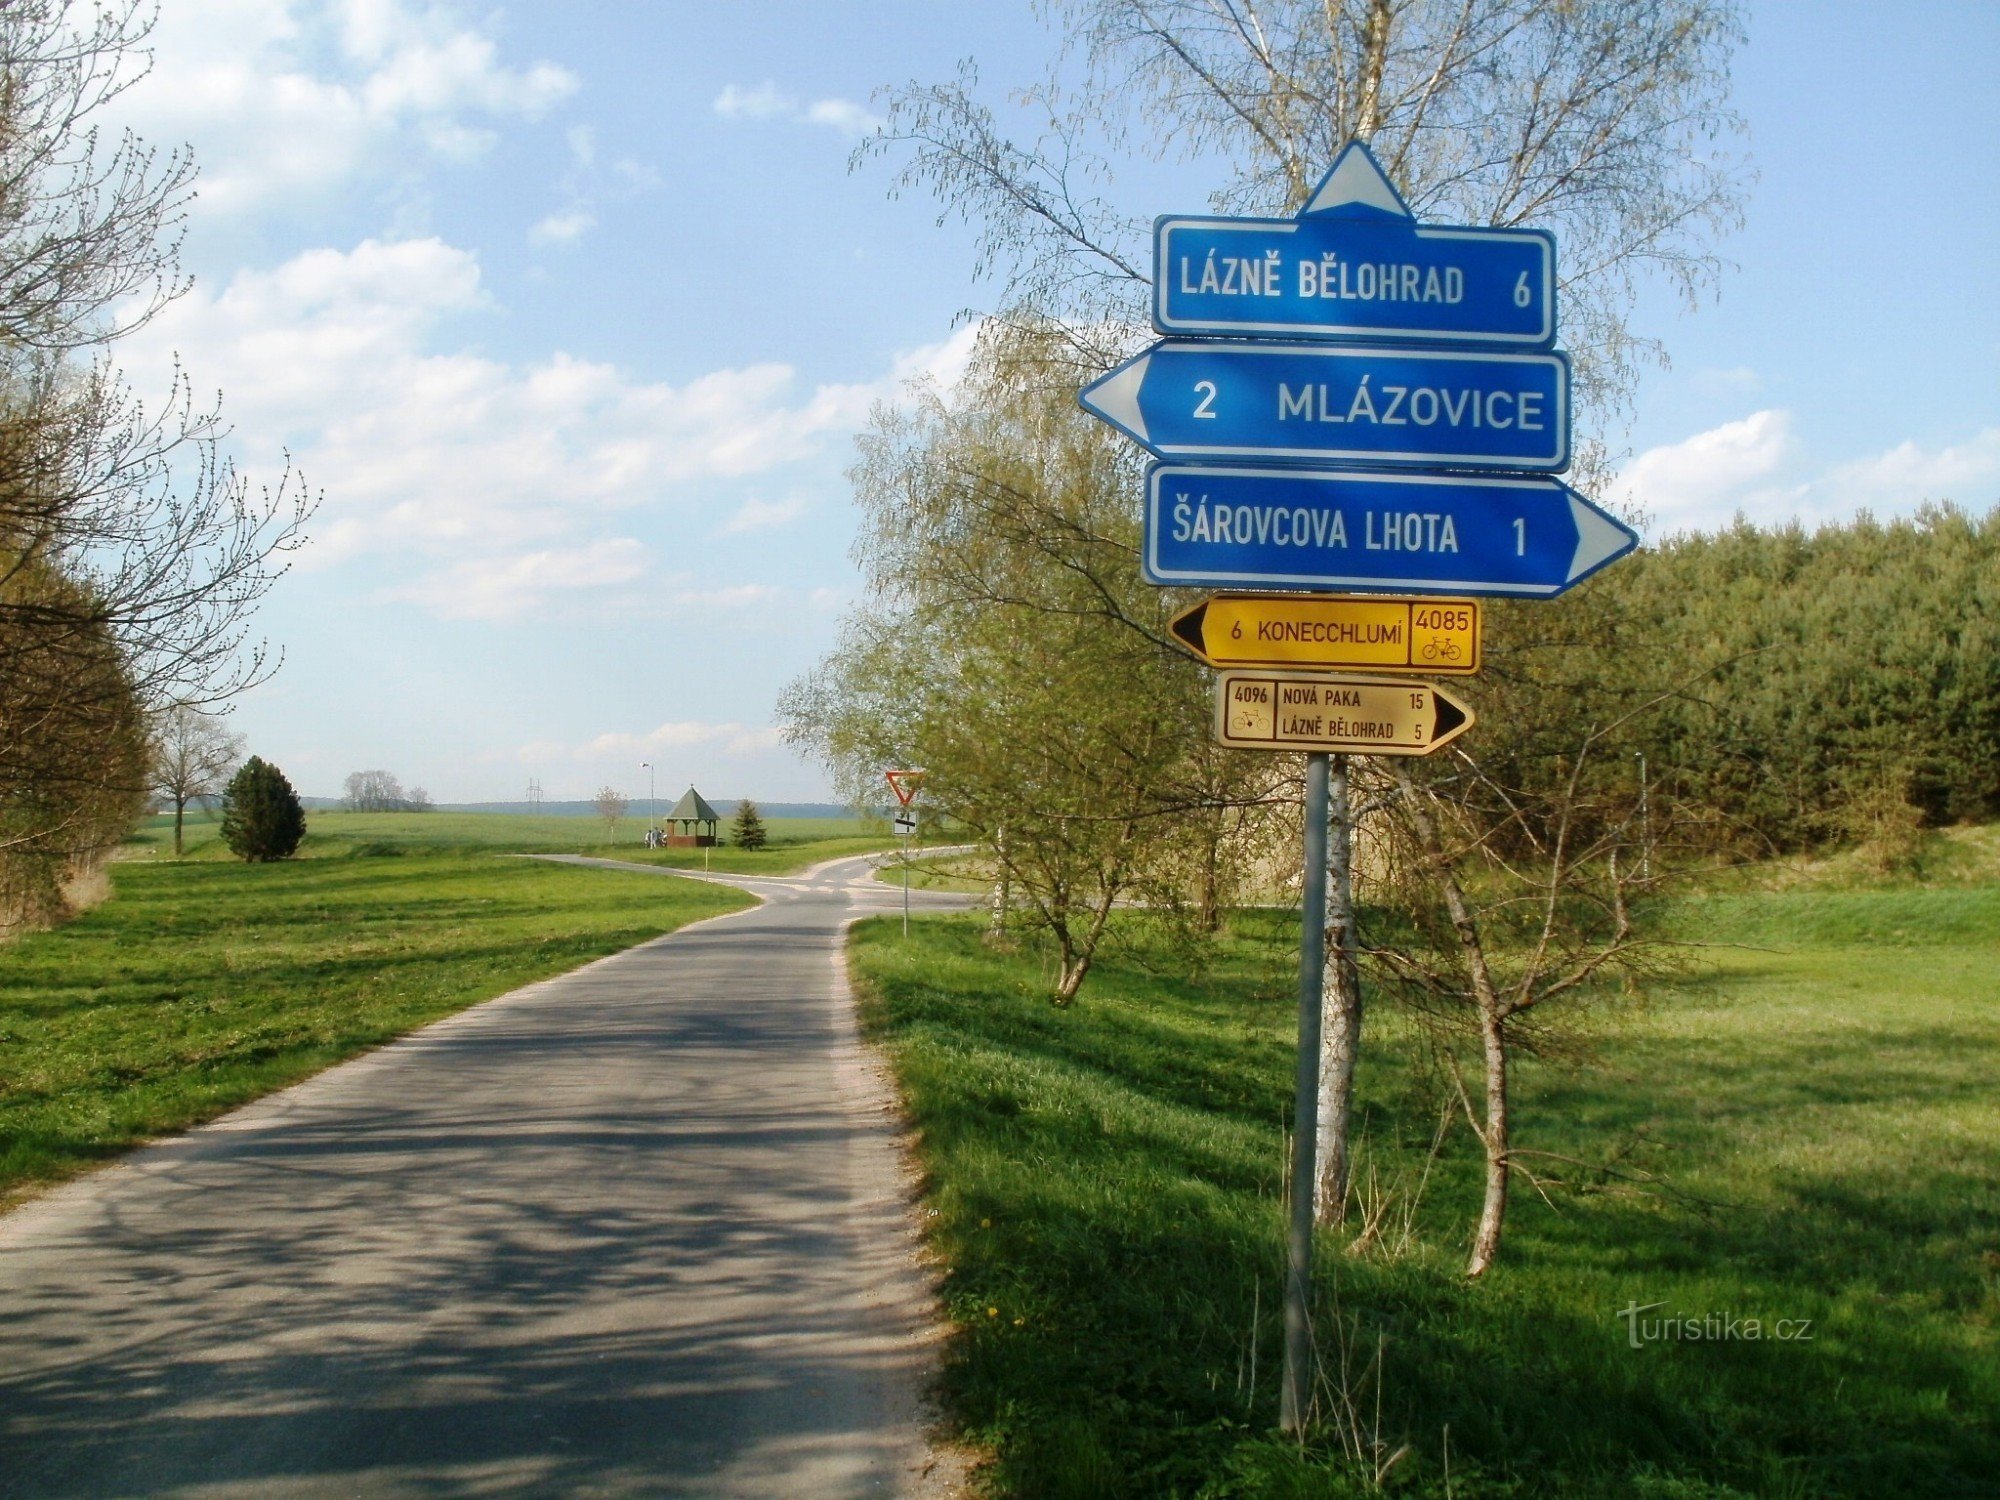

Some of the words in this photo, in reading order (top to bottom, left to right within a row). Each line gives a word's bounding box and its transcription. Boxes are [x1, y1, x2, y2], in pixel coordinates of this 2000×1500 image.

[1180, 248, 1281, 297] LÁZNĚ
[1300, 252, 1464, 303] BĚLOHRAD
[1514, 270, 1531, 308] 6
[1193, 381, 1217, 419] 2
[1278, 375, 1544, 431] MLÁZOVICE
[1172, 494, 1348, 549] ŠÁROVCOVA
[1365, 511, 1459, 553] LHOTA
[1512, 518, 1525, 557] 1
[1231, 620, 1242, 641] 6
[1258, 620, 1402, 645] KONECCHLUMÍ
[1415, 610, 1469, 632] 4085
[1234, 687, 1268, 704] 4096
[1283, 685, 1319, 706] NOVÁ
[1325, 690, 1361, 707] PAKA
[1409, 694, 1424, 710] 15
[1282, 715, 1323, 737] LÁZNĚ
[1329, 717, 1395, 740] BĚLOHRAD
[1414, 724, 1422, 740] 5
